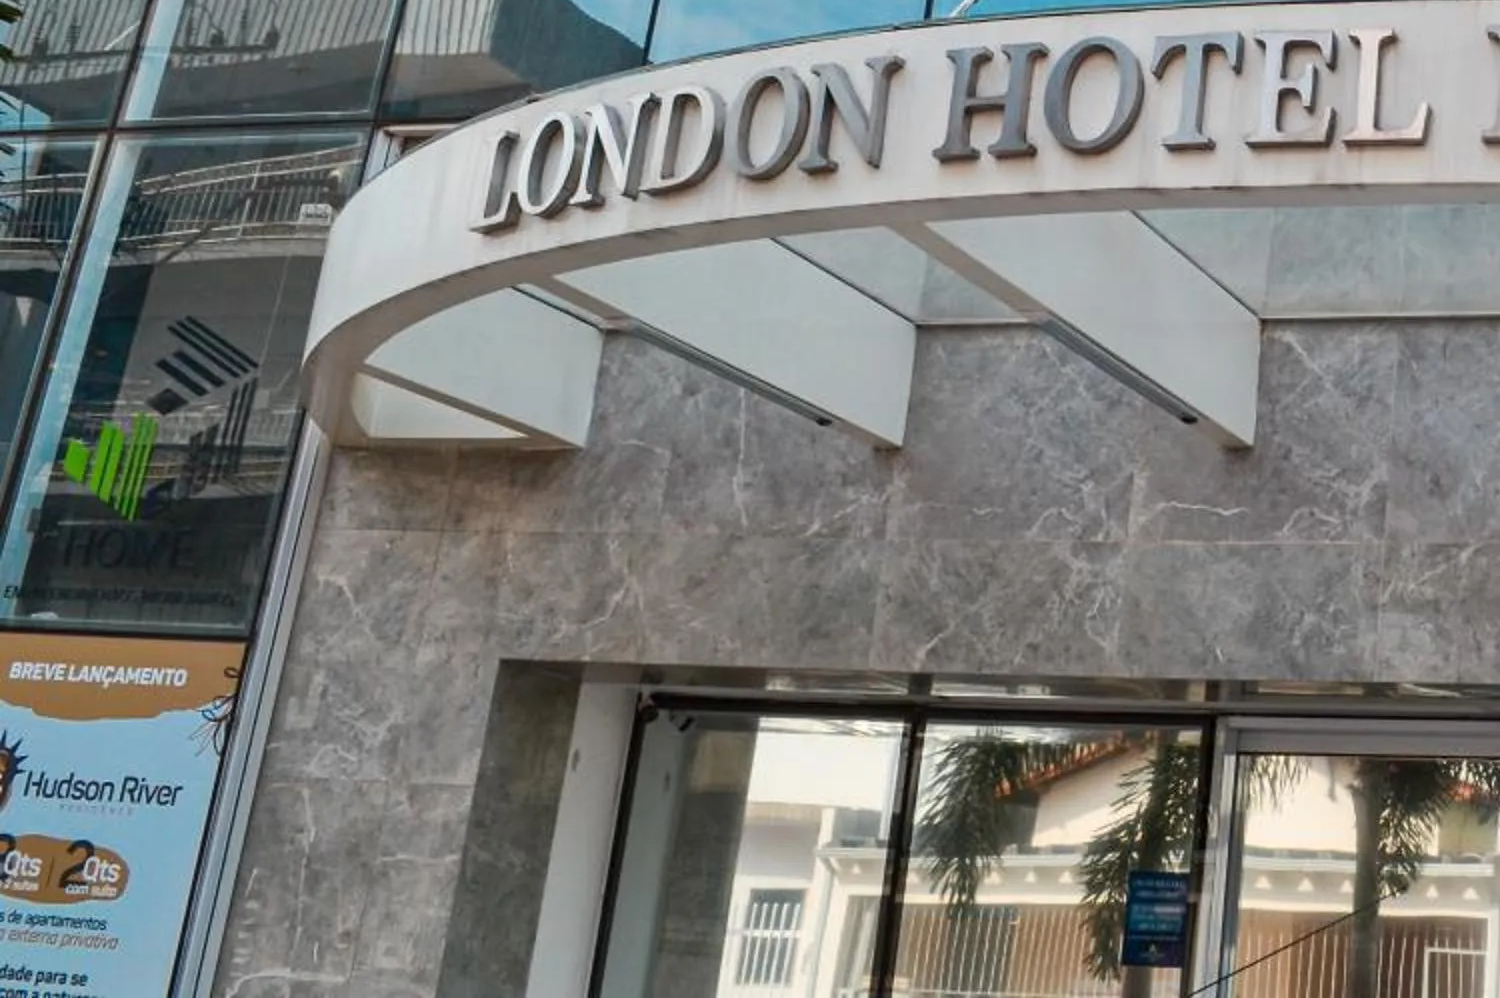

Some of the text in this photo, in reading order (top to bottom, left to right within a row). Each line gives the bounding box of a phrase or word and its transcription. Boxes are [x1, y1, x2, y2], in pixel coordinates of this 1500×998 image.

[469, 54, 905, 234] LONDON
[932, 28, 1431, 163] HOTEL
[9, 662, 188, 689] BREVE LANÇAMENTO
[23, 770, 184, 807] Hudson River
[8, 909, 22, 924] de
[24, 912, 108, 931] apartamentos
[59, 931, 119, 951] privativa
[33, 969, 67, 987] para
[70, 972, 88, 987] se
